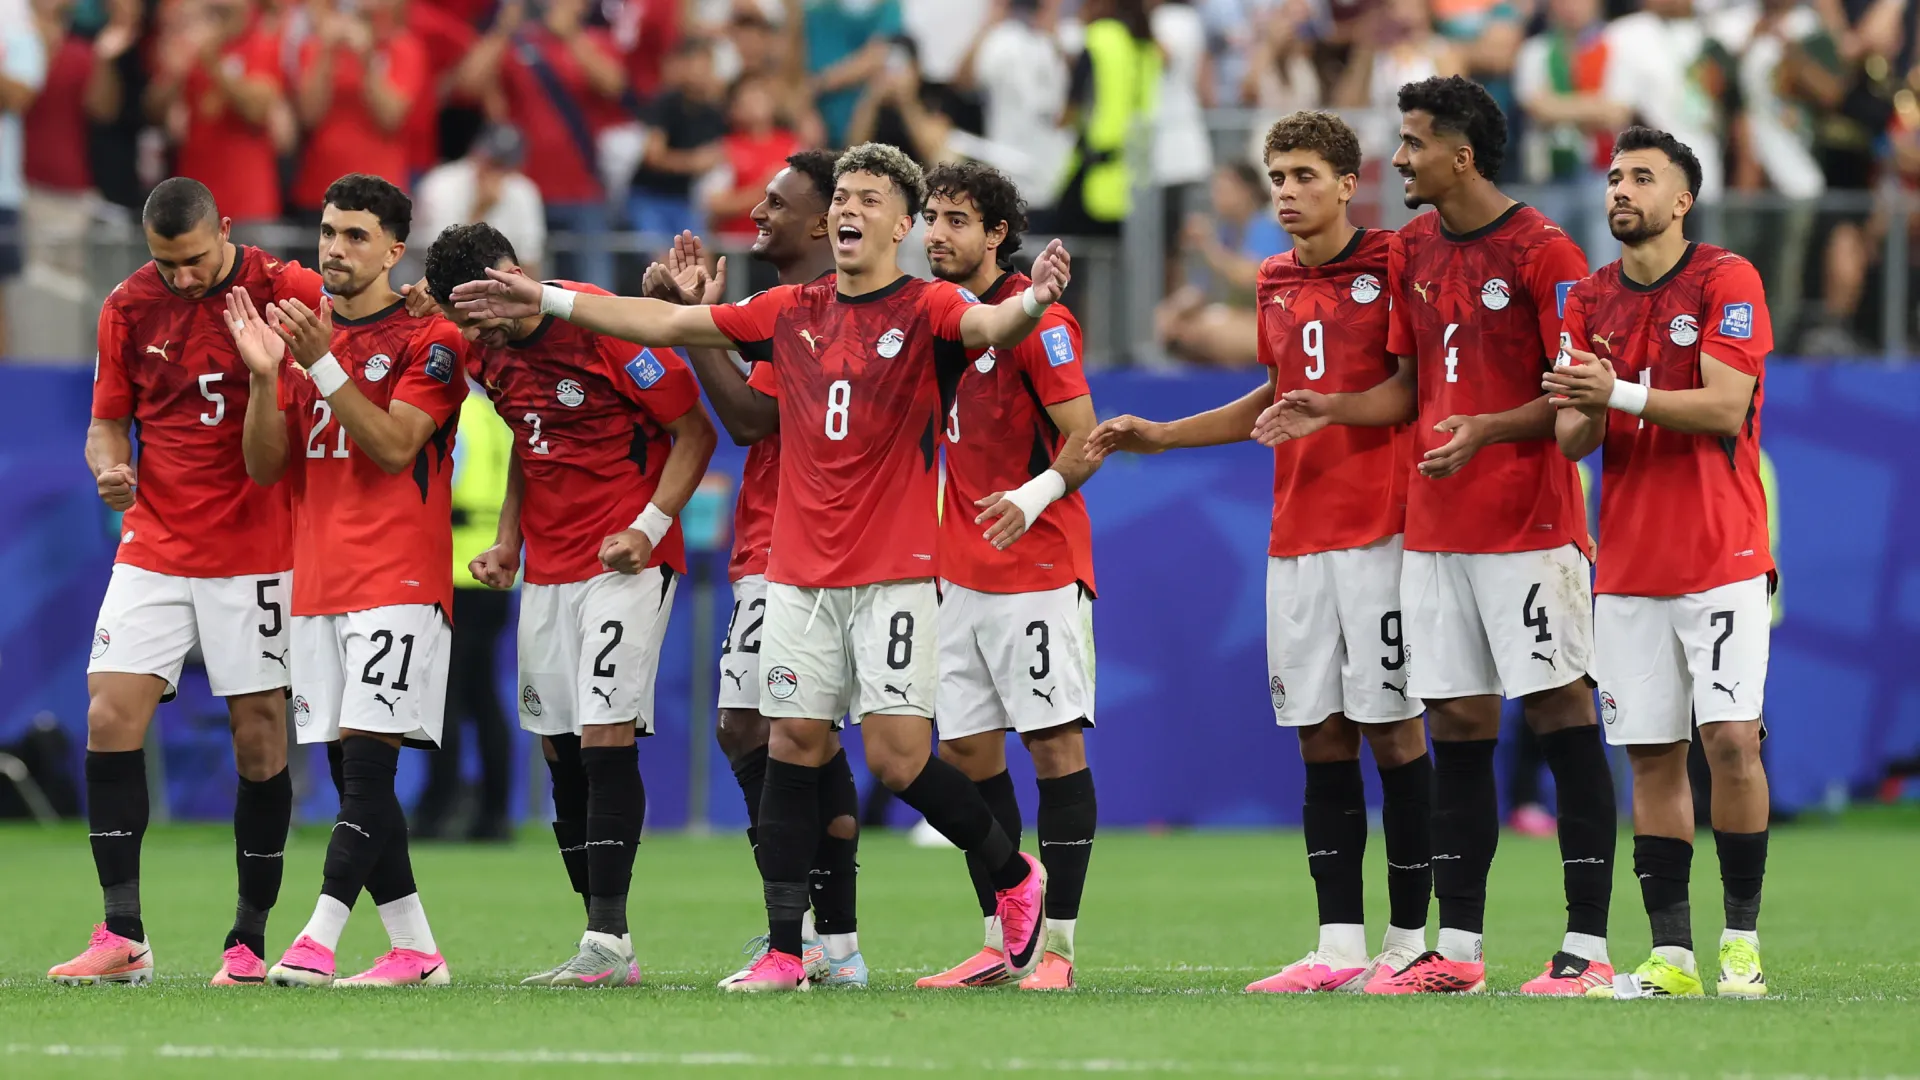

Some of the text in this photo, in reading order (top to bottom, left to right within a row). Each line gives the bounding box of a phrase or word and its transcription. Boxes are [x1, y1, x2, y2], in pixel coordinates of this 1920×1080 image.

[1303, 320, 1326, 381] 9
[1444, 324, 1462, 383] 4
[199, 373, 225, 426] 5
[306, 400, 350, 458] 21
[825, 379, 852, 441] 8
[523, 412, 550, 455] 2
[256, 579, 283, 638] 5
[722, 598, 766, 655] 12
[1523, 582, 1552, 643] 4
[362, 629, 415, 692] 21
[594, 620, 624, 678] 2
[887, 611, 914, 670] 8
[1026, 620, 1050, 681] 3
[1381, 610, 1406, 671] 9
[1710, 610, 1735, 671] 7
